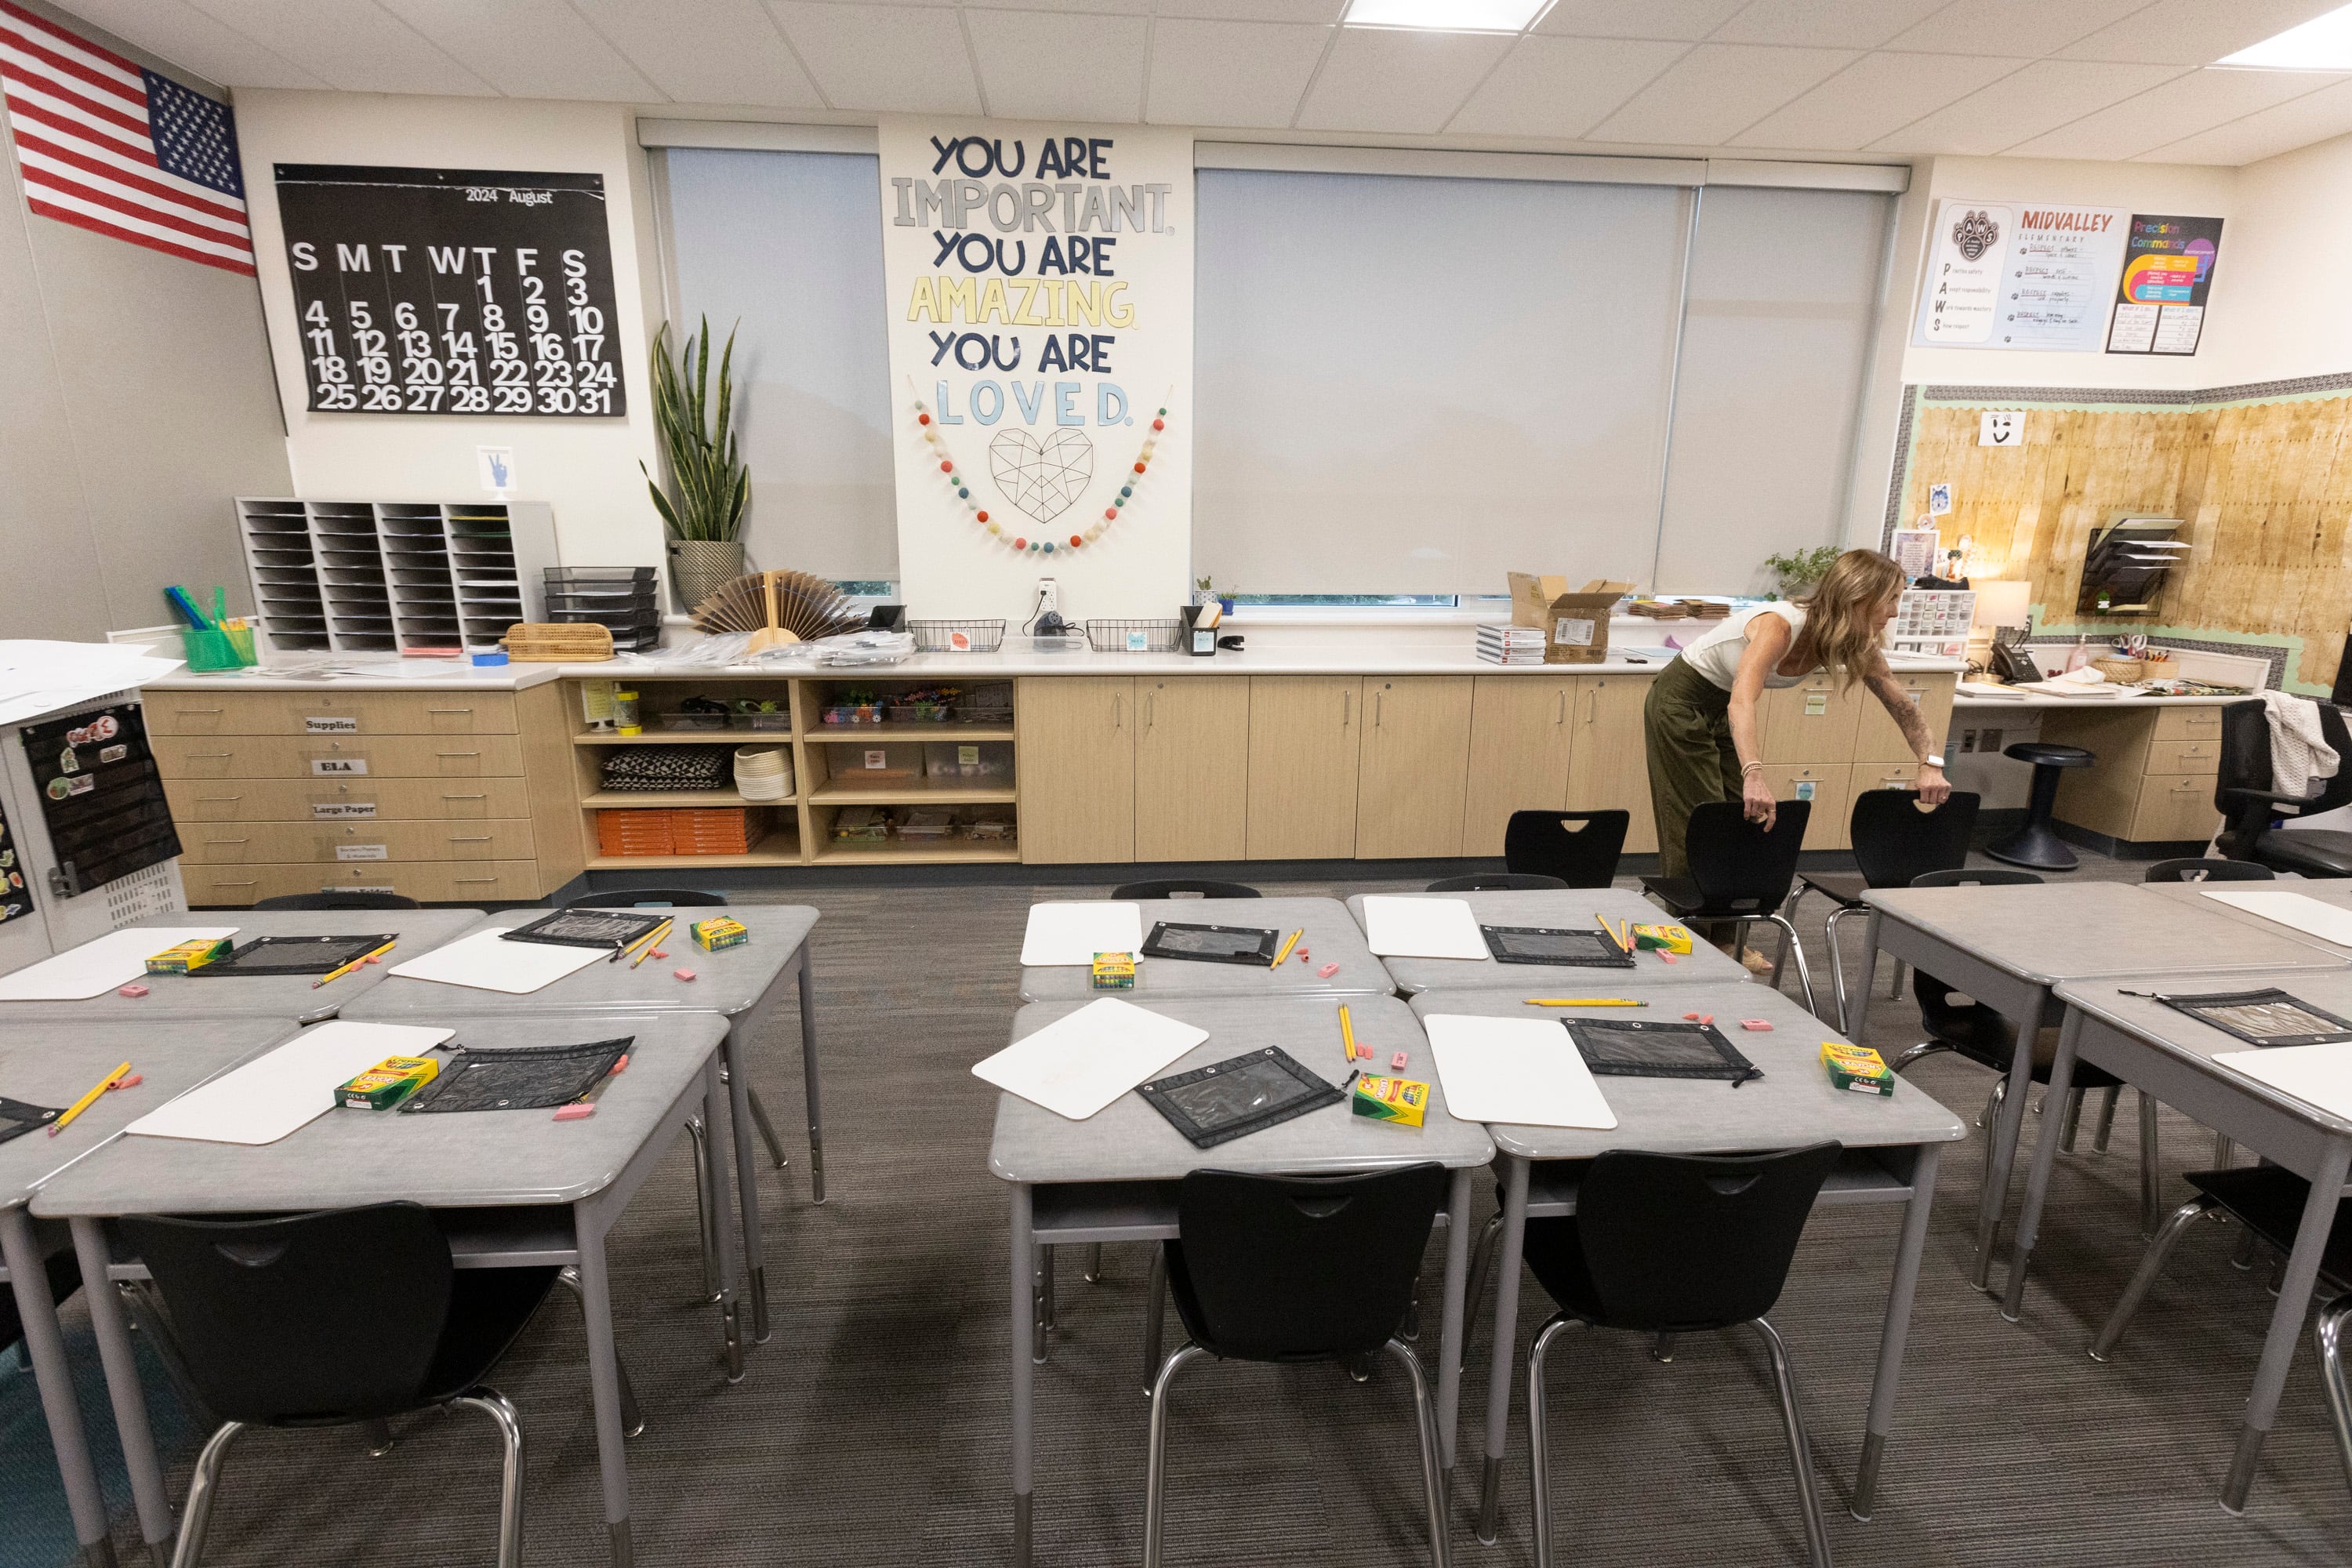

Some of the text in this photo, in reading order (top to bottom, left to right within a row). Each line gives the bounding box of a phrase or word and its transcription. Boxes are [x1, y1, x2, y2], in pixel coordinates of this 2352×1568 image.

[931, 136, 1113, 180] YOU ARE
[466, 189, 553, 205] 2024 August
[891, 177, 1174, 236] IMPORTANT.
[2021, 211, 2113, 232] MIDVALLEY
[2133, 221, 2180, 234] Precision
[932, 230, 1116, 277] YOU ARE
[2019, 234, 2085, 243] ELEMENTARY
[2132, 236, 2186, 249] Commands
[292, 242, 586, 278] S M T W T F S
[477, 276, 588, 306] 1 2 3
[907, 277, 1139, 330] AMAZING.
[305, 301, 604, 334] 4 5 6 7 8 9 10
[308, 329, 604, 361] 11 12 13 14 15 16 17
[929, 331, 1115, 373] YOU ARE
[312, 357, 617, 388] 18 19 20 21 22 23 24
[317, 383, 611, 414] 25 26 27 28 29 30 31
[937, 380, 1133, 426] LOVED.
[306, 719, 356, 731] Supplies
[321, 762, 351, 772] ELA
[314, 804, 376, 816] Large Paper
[1838, 1061, 1882, 1071] CRAYONS
[1414, 1086, 1425, 1105] Crayola
